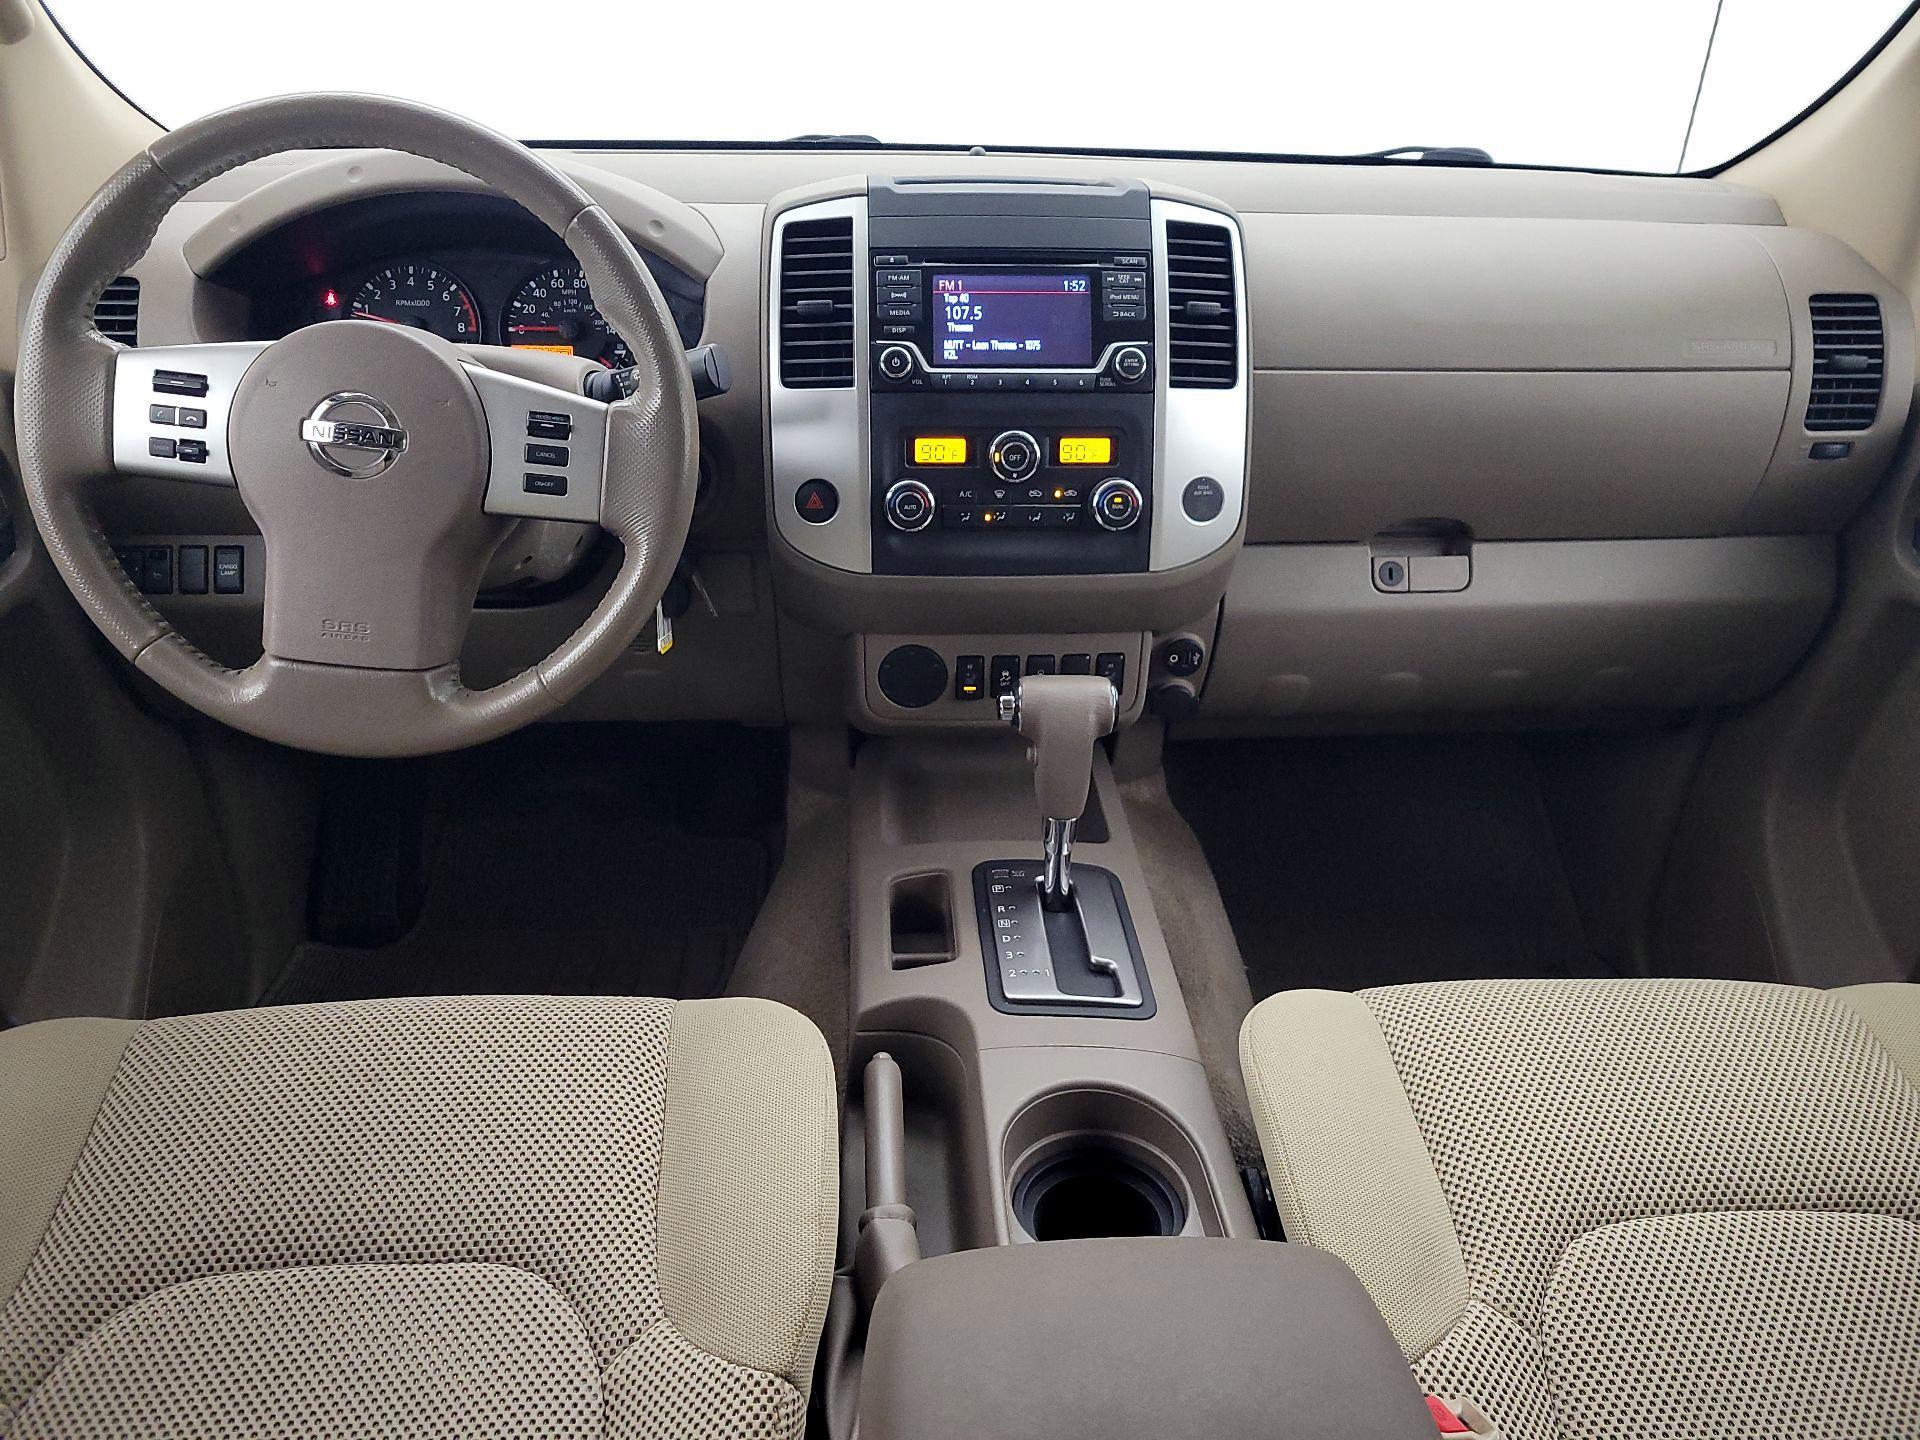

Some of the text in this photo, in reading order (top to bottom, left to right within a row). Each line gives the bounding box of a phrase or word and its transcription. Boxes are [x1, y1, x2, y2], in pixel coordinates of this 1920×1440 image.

[390, 280, 396, 290] 3
[407, 277, 414, 287] 4
[428, 281, 435, 290] 5
[550, 279, 564, 288] 60
[573, 279, 587, 288] 80
[939, 280, 963, 291] FM 1
[1063, 280, 1086, 291] 1:52
[374, 290, 381, 300] 2
[442, 291, 450, 301] 6
[533, 288, 547, 298] 40
[364, 304, 369, 314] 1
[453, 307, 461, 317] 7
[522, 304, 536, 313] 20
[945, 305, 983, 320] 107.5
[457, 322, 465, 333] 8
[312, 424, 395, 446] NISSAN
[535, 451, 556, 459] CANCEL
[959, 490, 972, 498] A/C
[322, 619, 370, 633] SRS
[1008, 969, 1017, 977] 2
